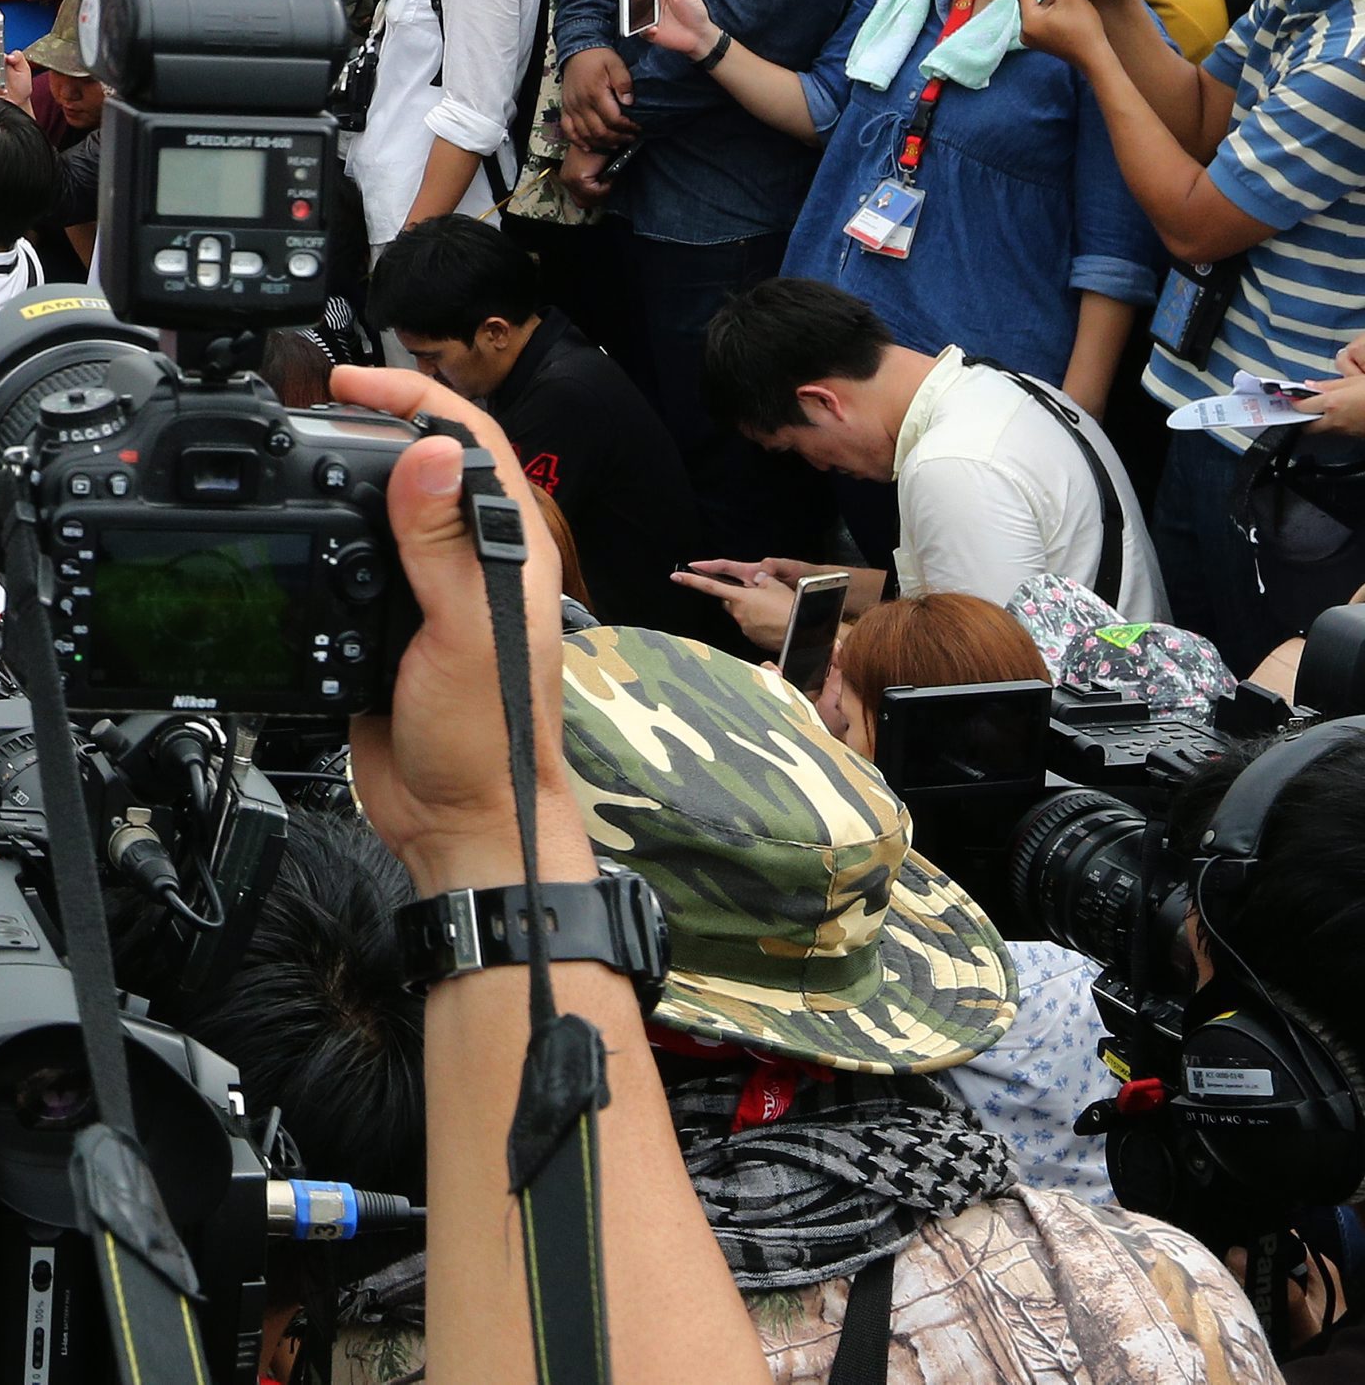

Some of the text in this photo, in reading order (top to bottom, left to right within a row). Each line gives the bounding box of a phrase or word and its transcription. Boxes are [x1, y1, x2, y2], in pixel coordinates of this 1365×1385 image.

[186, 134, 253, 148] SPEEDLIGHT
[287, 156, 318, 167] READY
[287, 189, 318, 199] FLASH
[286, 236, 325, 248] ON/OFF
[260, 283, 290, 294] RESET
[172, 695, 217, 709] Nikon
[1200, 1113, 1217, 1124] 770
[315, 1224, 338, 1237] 3
[34, 1299, 45, 1324] 100%
[61, 1332, 69, 1356] Li-ion
